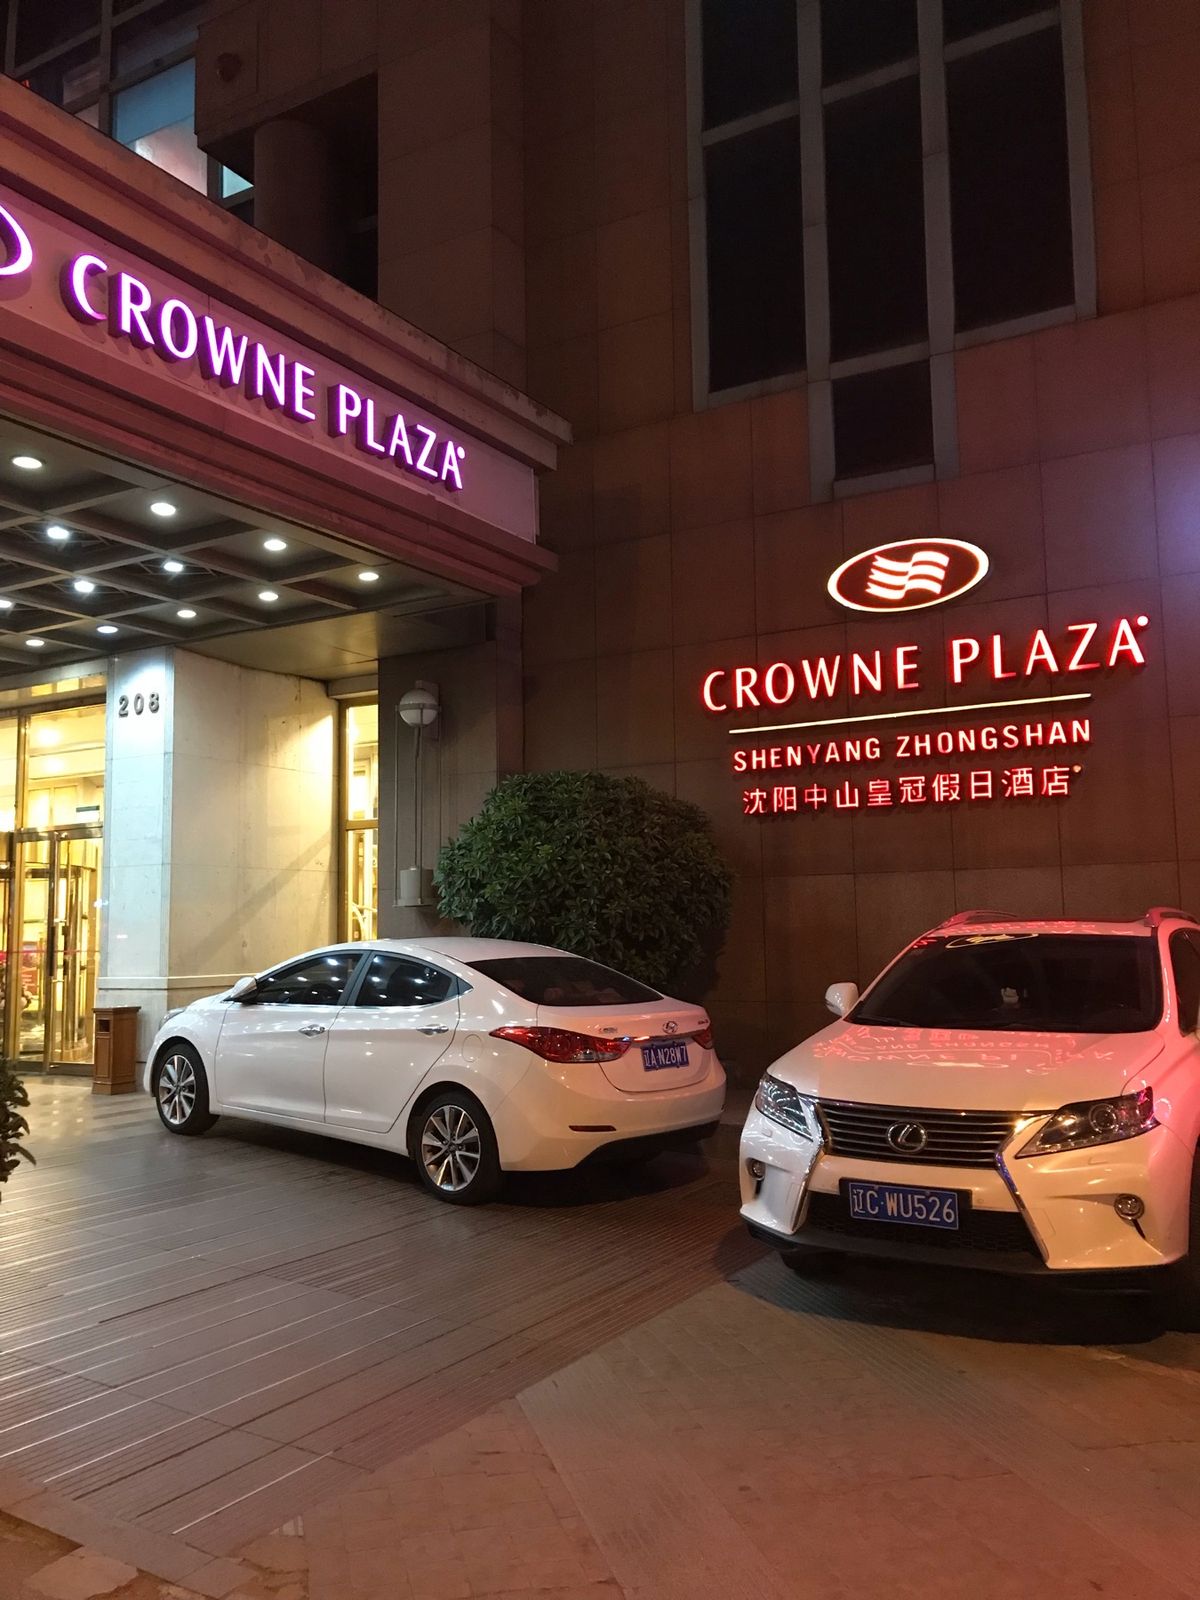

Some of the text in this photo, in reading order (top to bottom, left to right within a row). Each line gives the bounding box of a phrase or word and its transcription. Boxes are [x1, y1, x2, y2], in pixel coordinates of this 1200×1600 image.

[70, 254, 466, 489] CROWNE PLAZA
[702, 615, 1149, 712] CROWNE PLAZA
[118, 692, 160, 718] 208
[733, 719, 1091, 772] SHENYANG ZHONGSHAN
[743, 766, 1071, 815] 沈阳中山皇冠假日酒店
